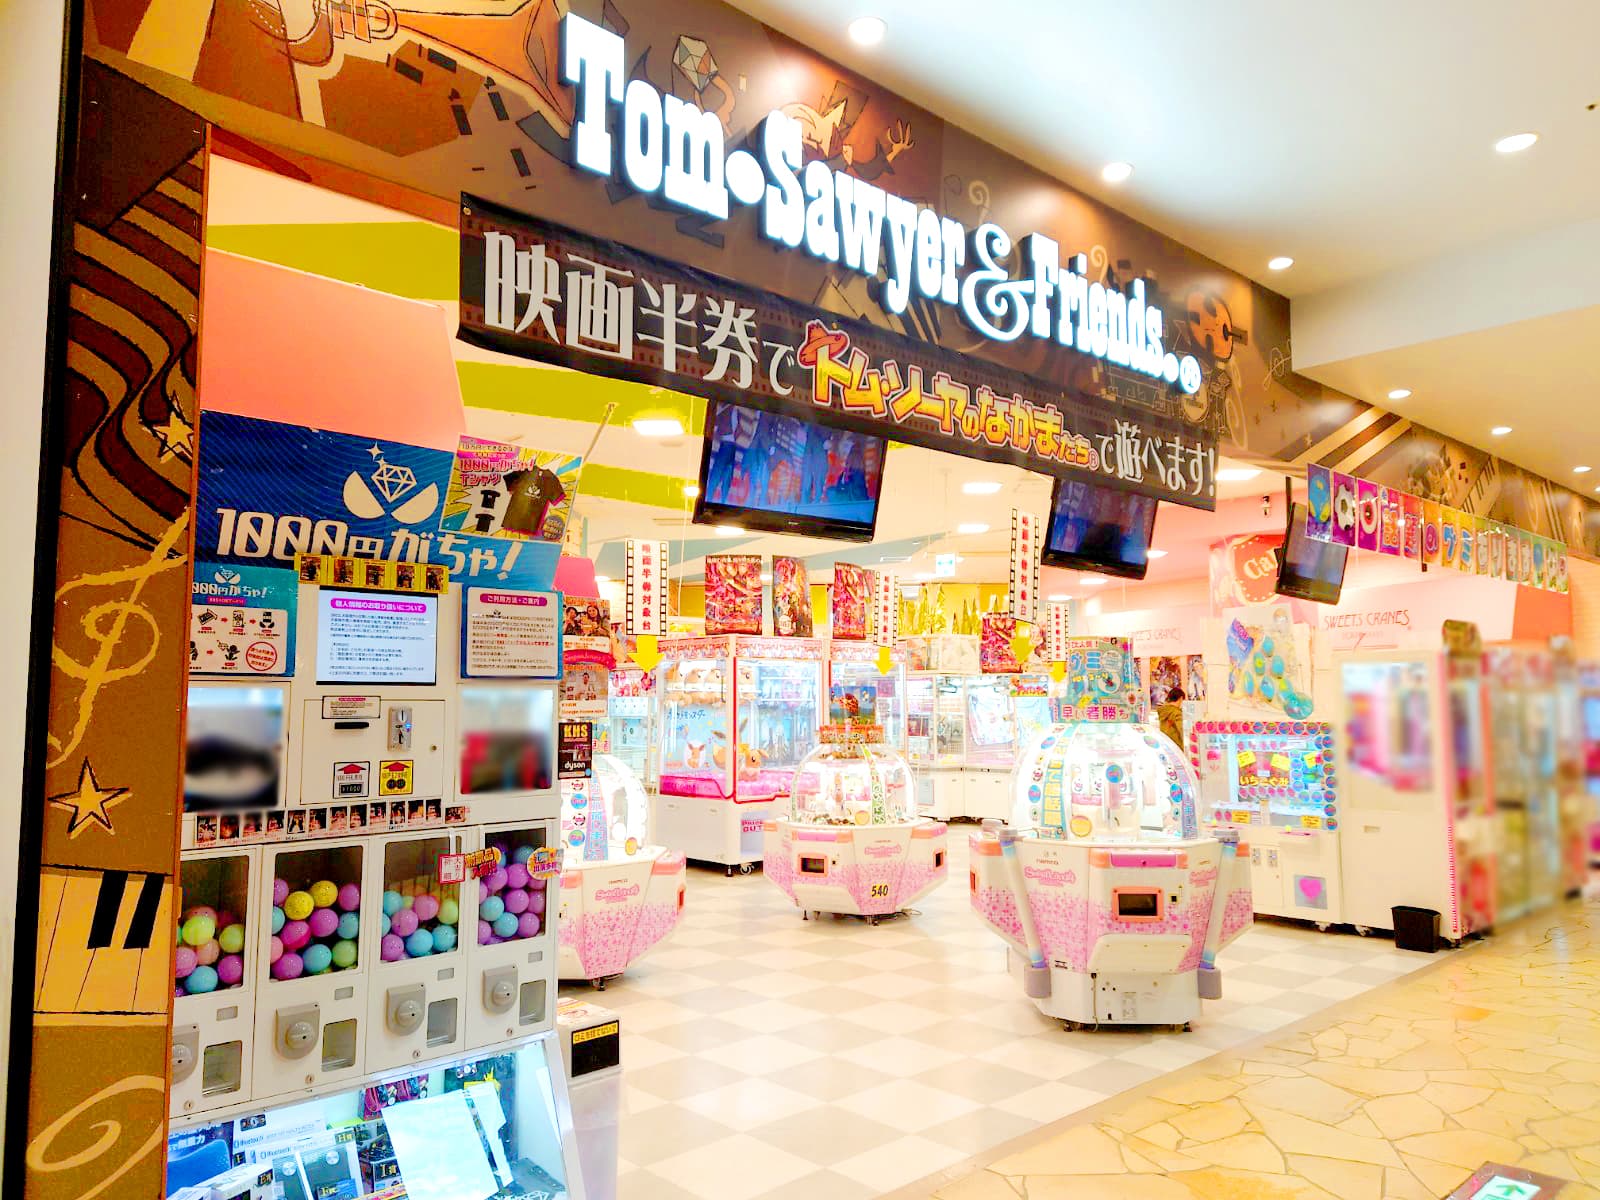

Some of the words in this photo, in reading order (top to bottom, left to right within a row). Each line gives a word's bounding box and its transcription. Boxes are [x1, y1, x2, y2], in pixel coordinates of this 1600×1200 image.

[215, 506, 523, 581] 1000円がちゃ!
[1366, 609, 1411, 626] CRANES
[1062, 704, 1130, 720] 早い者勝ち
[564, 761, 586, 771] dyson
[871, 884, 889, 898] 540
